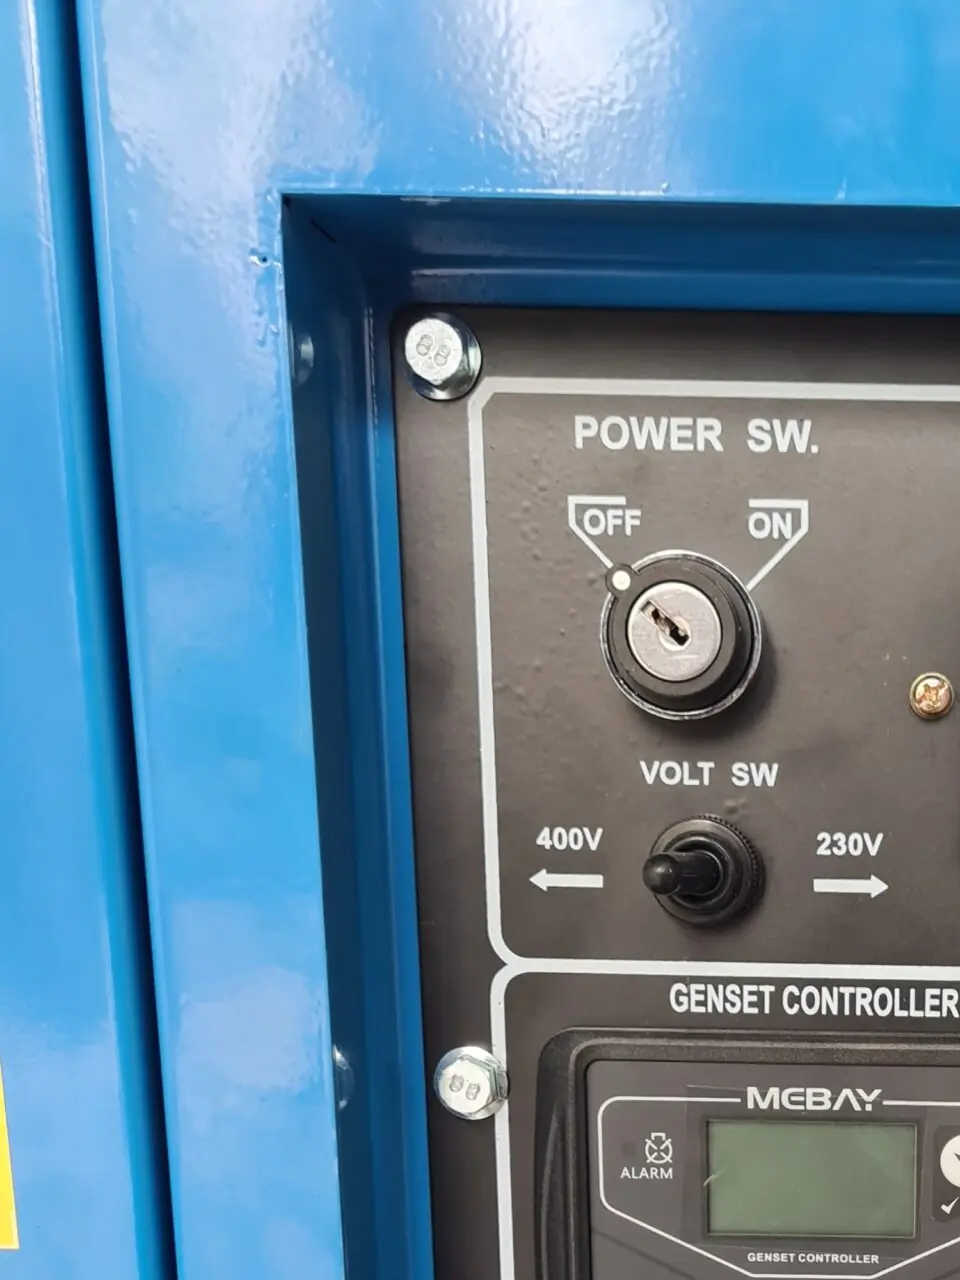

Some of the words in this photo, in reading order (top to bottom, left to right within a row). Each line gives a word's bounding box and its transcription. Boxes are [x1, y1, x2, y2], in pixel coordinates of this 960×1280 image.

[575, 416, 724, 451] POWER
[747, 419, 819, 454] SW.
[582, 508, 642, 536] OFF
[748, 511, 793, 539] ON
[639, 761, 715, 786] VOLT
[732, 762, 779, 788] SW
[536, 827, 604, 851] 400V
[816, 832, 884, 857] 230V
[669, 982, 775, 1014] GENSET
[782, 985, 960, 1018] CONTROLLER
[747, 1086, 882, 1111] MEBAY
[620, 1167, 674, 1180] ALARM
[747, 1252, 796, 1263] GENSET
[798, 1253, 880, 1264] CONTROLLER
